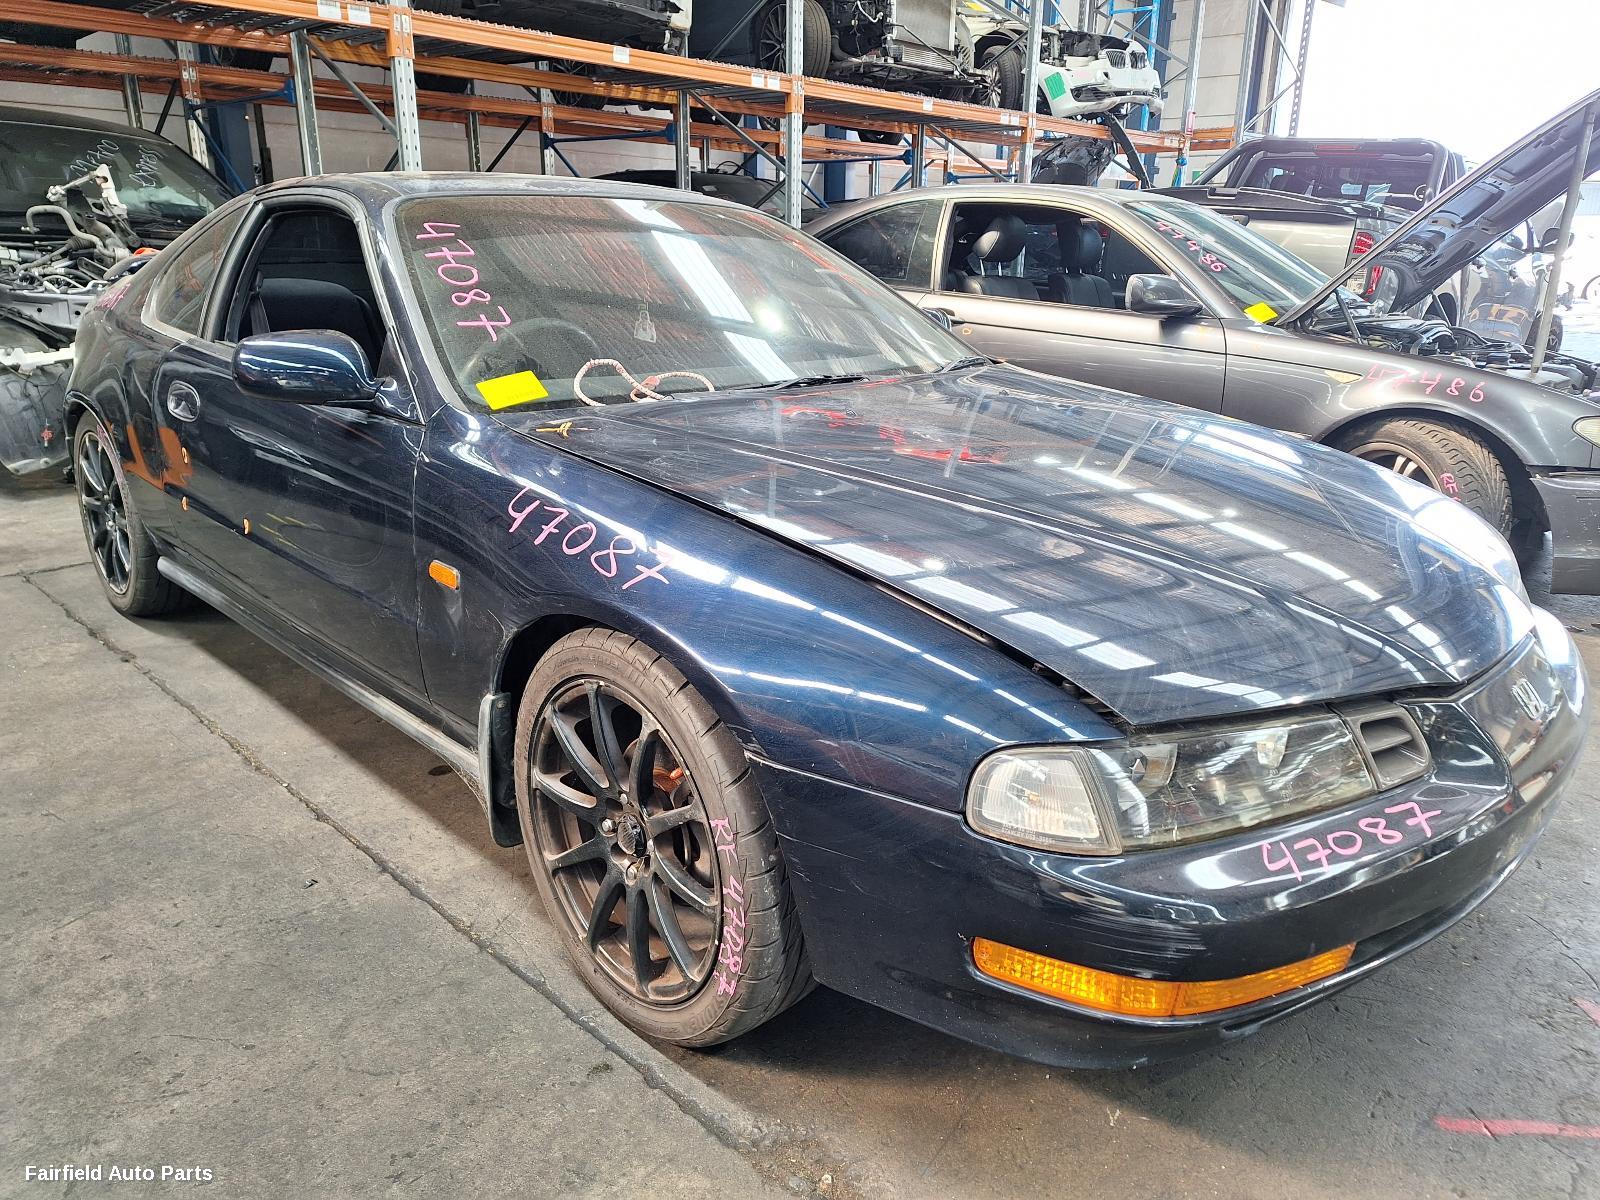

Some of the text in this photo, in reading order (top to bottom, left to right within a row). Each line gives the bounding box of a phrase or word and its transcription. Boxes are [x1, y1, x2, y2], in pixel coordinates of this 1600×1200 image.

[415, 221, 513, 342] 47087
[1362, 363, 1486, 402] 47486
[507, 484, 673, 590] 47087
[1261, 801, 1443, 883] 47087
[709, 816, 746, 996] RF 47087
